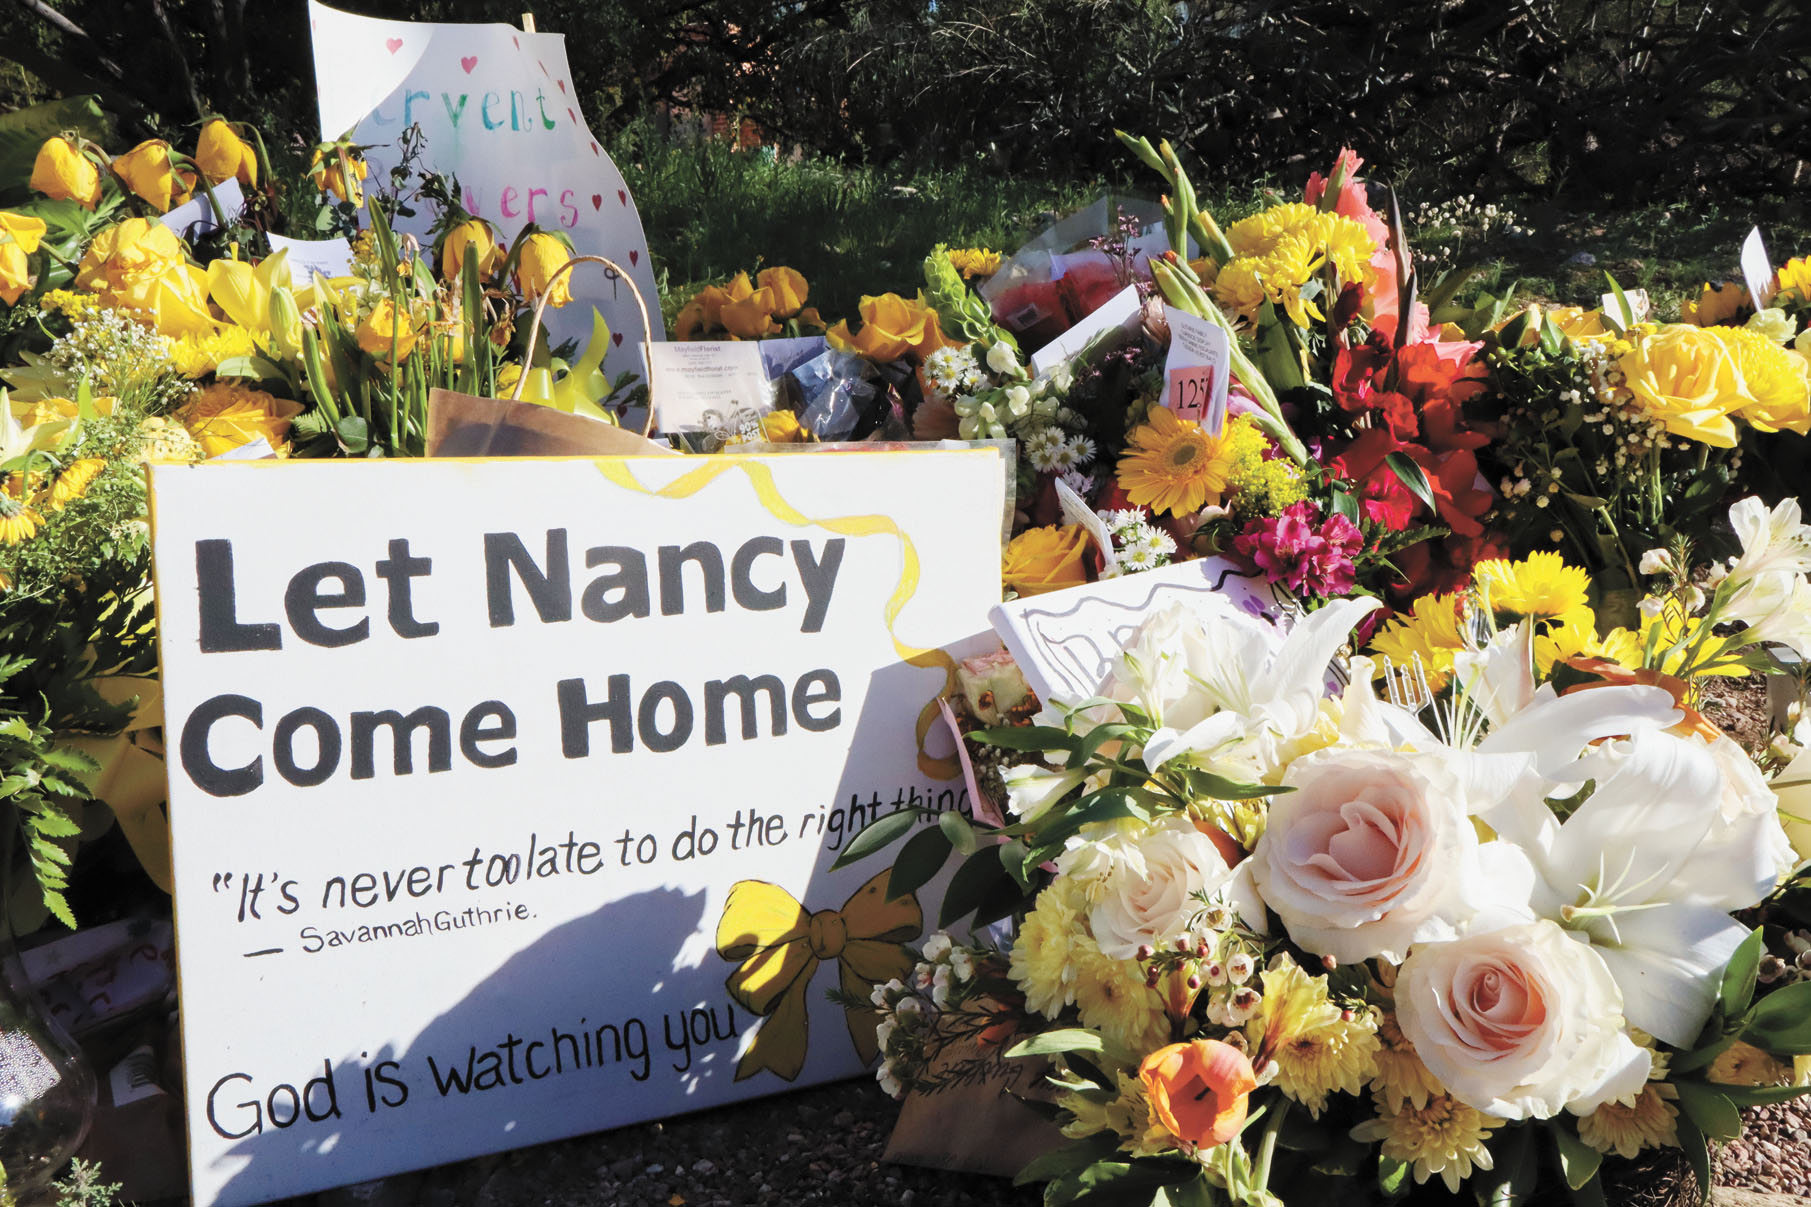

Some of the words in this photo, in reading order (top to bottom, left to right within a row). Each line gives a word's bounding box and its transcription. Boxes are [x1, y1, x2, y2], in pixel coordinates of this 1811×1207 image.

[195, 538, 440, 654] Let
[483, 527, 846, 633] Nancy
[180, 693, 518, 797] Come
[556, 668, 842, 759] Home
[322, 863, 455, 909] never
[614, 828, 658, 867] to
[671, 815, 719, 862] do
[726, 808, 788, 851] the
[798, 790, 883, 851] right
[206, 1057, 342, 1139] God
[360, 1051, 409, 1113] is
[663, 1003, 738, 1073] you
